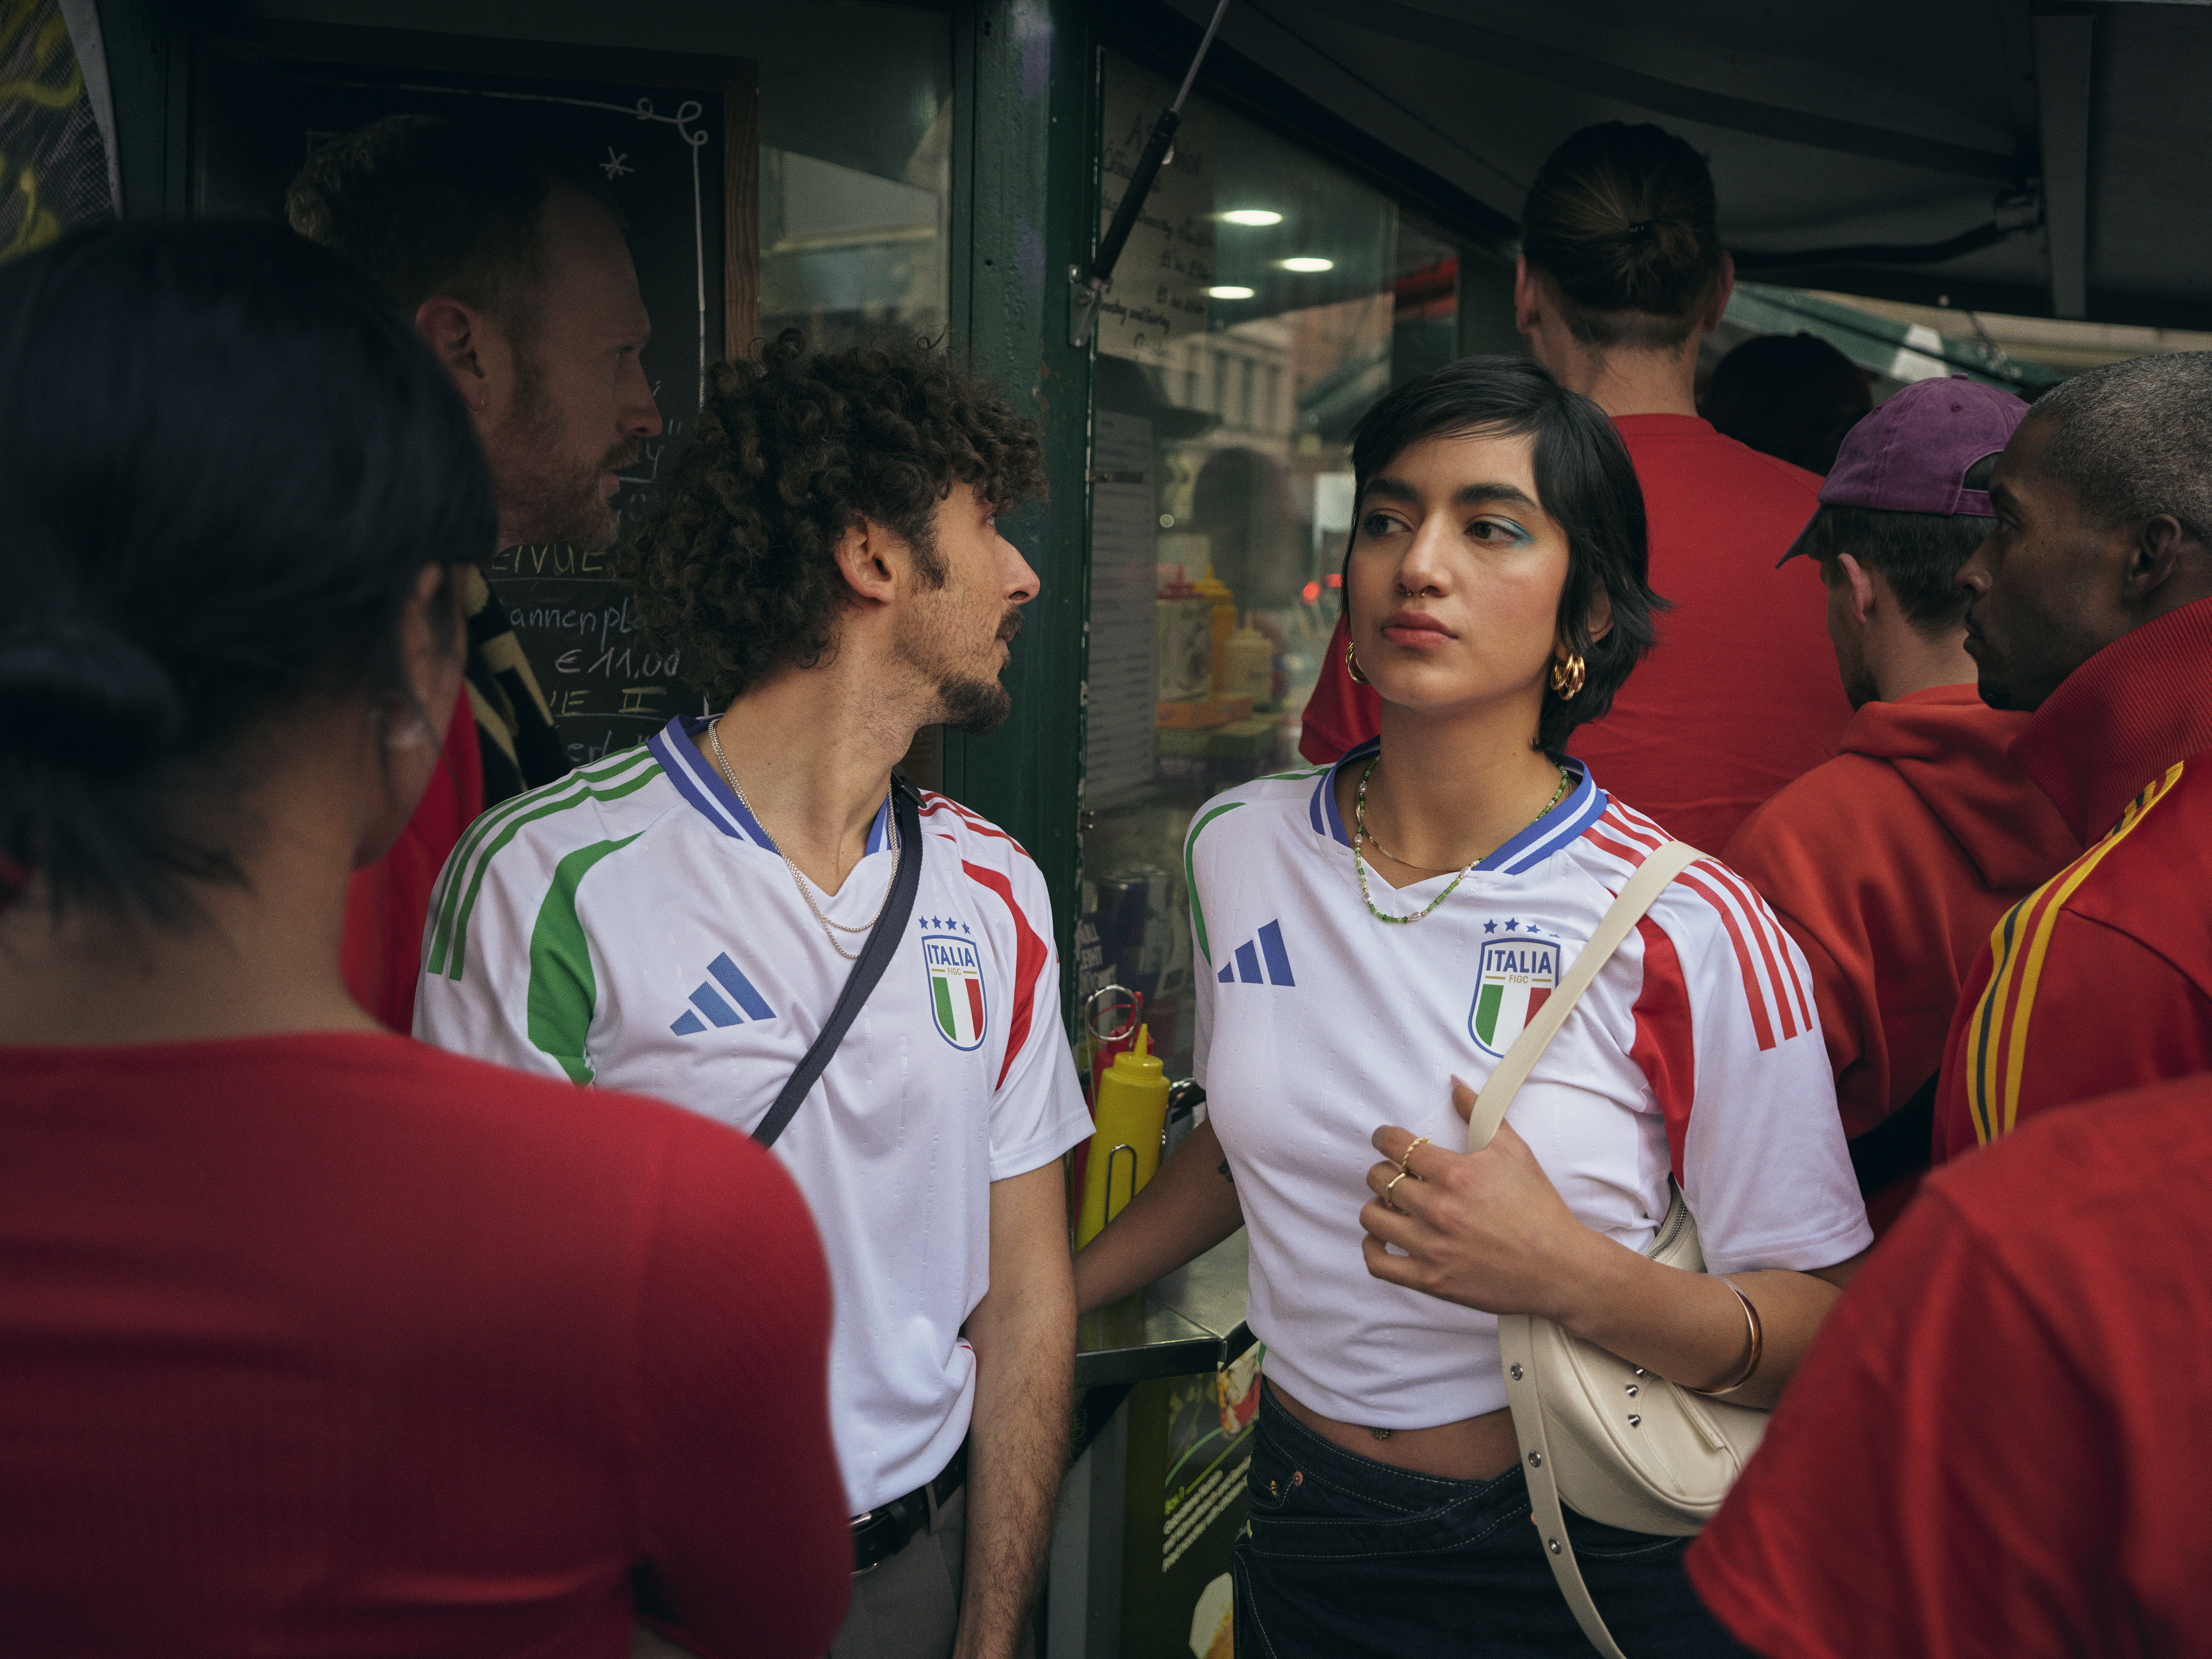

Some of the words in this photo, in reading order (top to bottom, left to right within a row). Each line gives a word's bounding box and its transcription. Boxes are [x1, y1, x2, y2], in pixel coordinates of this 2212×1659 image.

[500, 597, 645, 653] annenpl
[927, 944, 976, 967] ITALIA
[1486, 949, 1552, 974] ITALIA
[947, 967, 961, 975] FIGC
[1509, 975, 1529, 984] FIGC
